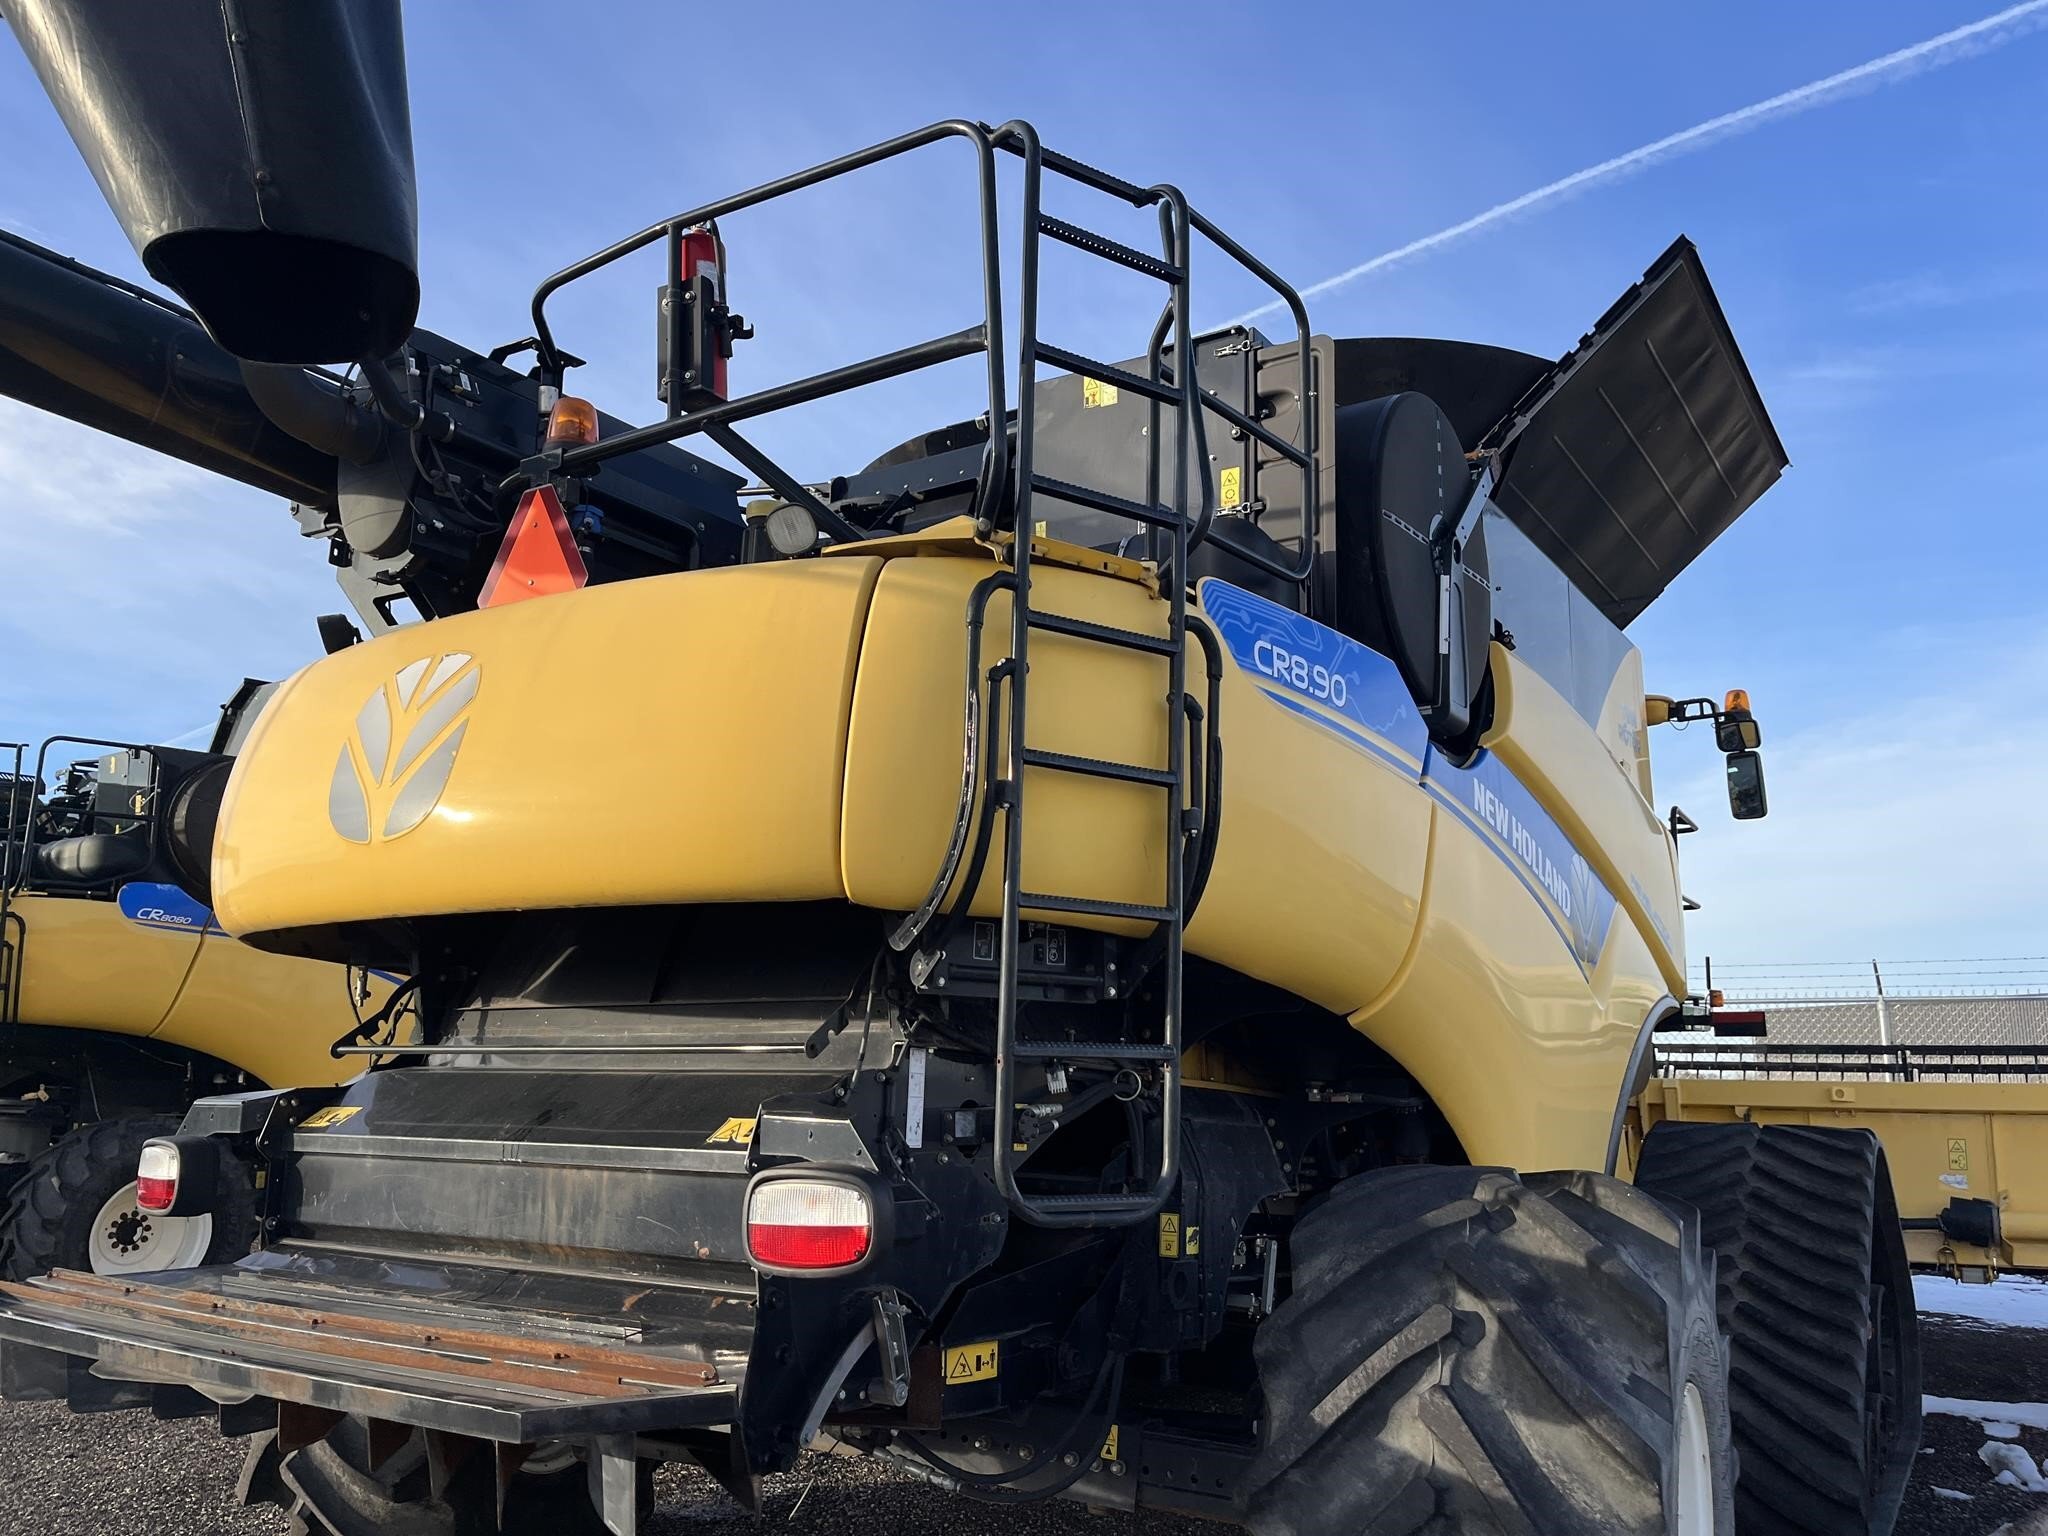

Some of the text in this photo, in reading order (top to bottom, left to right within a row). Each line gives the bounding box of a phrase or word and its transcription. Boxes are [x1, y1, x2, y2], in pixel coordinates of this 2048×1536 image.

[1253, 639, 1347, 708] CR8.90
[1473, 777, 1571, 918] NEW HOLLAND
[136, 908, 192, 924] CR8080
